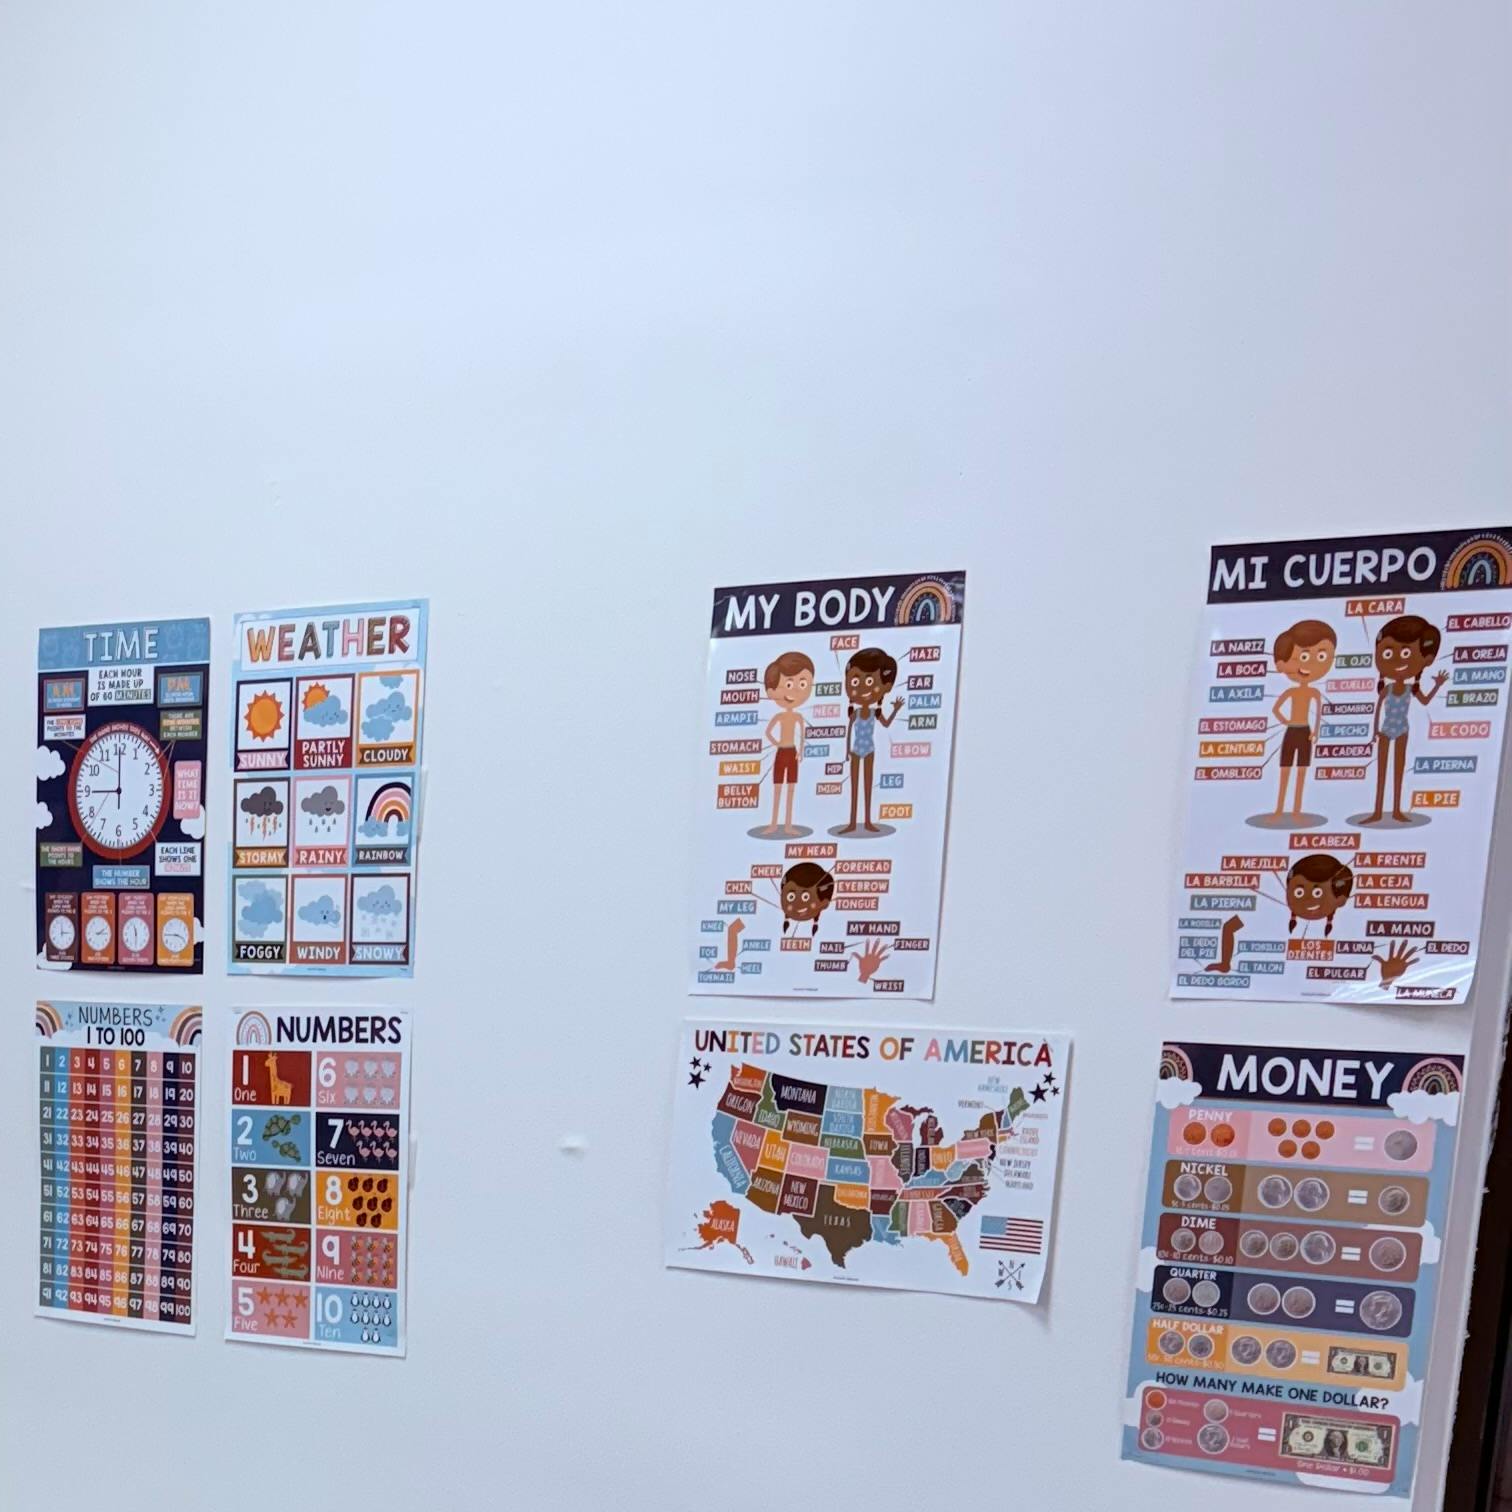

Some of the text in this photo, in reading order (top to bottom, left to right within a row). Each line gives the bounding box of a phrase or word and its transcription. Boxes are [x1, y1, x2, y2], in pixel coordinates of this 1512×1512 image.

[1212, 547, 1436, 592] MI CUERPO
[724, 594, 780, 632] MY
[794, 586, 896, 627] BODY
[1348, 601, 1403, 614] LA CARA
[84, 627, 159, 662] TIME
[247, 615, 411, 664] WEATHER
[832, 637, 857, 649] FACE
[911, 648, 939, 659] HAIR
[99, 668, 142, 679] EACH HOUR
[728, 671, 756, 682] NOSE
[1219, 664, 1265, 676] LA BOCA
[98, 679, 143, 689] IS MADE UP
[909, 678, 931, 687] EAR
[90, 692, 100, 701] OF
[103, 692, 113, 700] 60
[722, 692, 758, 702] MOUTH
[817, 685, 839, 695] EYES
[910, 717, 935, 727] ARM
[302, 740, 345, 754] PARTLY
[240, 752, 285, 768] SUNNY
[303, 754, 343, 767] SUNNY
[363, 749, 408, 762] CLOUDY
[882, 777, 902, 786] LEG
[1415, 793, 1457, 804] EL PIE
[881, 807, 910, 817] FOOT
[239, 851, 284, 864] STORMY
[299, 850, 343, 864] RAINY
[359, 850, 403, 860] RAINBOW
[788, 846, 834, 856] MY HEAD
[849, 924, 898, 934] MY HAND
[1370, 923, 1431, 935] LA MANO
[240, 945, 280, 959] FOGGY
[297, 946, 340, 960] WINDY
[356, 947, 404, 959] SNOWY
[79, 1006, 153, 1026] NUMBERS
[96, 1028, 115, 1045] TO
[277, 1016, 402, 1044] NUMBERS
[695, 1029, 1052, 1067] UNITED STATES OF AMERICA
[319, 1057, 336, 1087] 6
[1216, 1054, 1395, 1100] MONEY
[234, 1088, 256, 1102] One
[781, 1086, 817, 1103] MONTANA
[726, 1094, 754, 1114] OREGON
[1188, 1110, 1232, 1121] PENNY
[237, 1116, 253, 1145] 2
[328, 1118, 344, 1149] 7
[734, 1131, 761, 1149] NEVADA
[234, 1147, 256, 1161] Two
[317, 1151, 356, 1165] Seven
[1180, 1163, 1228, 1176] NICKEL
[242, 1174, 259, 1203] 3
[326, 1175, 343, 1205] 8
[233, 1204, 268, 1219] Three
[1181, 1217, 1216, 1229] DIME
[238, 1230, 256, 1259] 4
[322, 1235, 340, 1265] 9
[233, 1259, 260, 1274] Four
[1170, 1268, 1217, 1280] QUARTER
[238, 1287, 254, 1316] 5
[317, 1293, 343, 1323] 10
[234, 1317, 258, 1331] Five
[319, 1325, 341, 1338] Ten
[1156, 1372, 1389, 1409] HOW MANY MAKE ONE DOLLAR?
